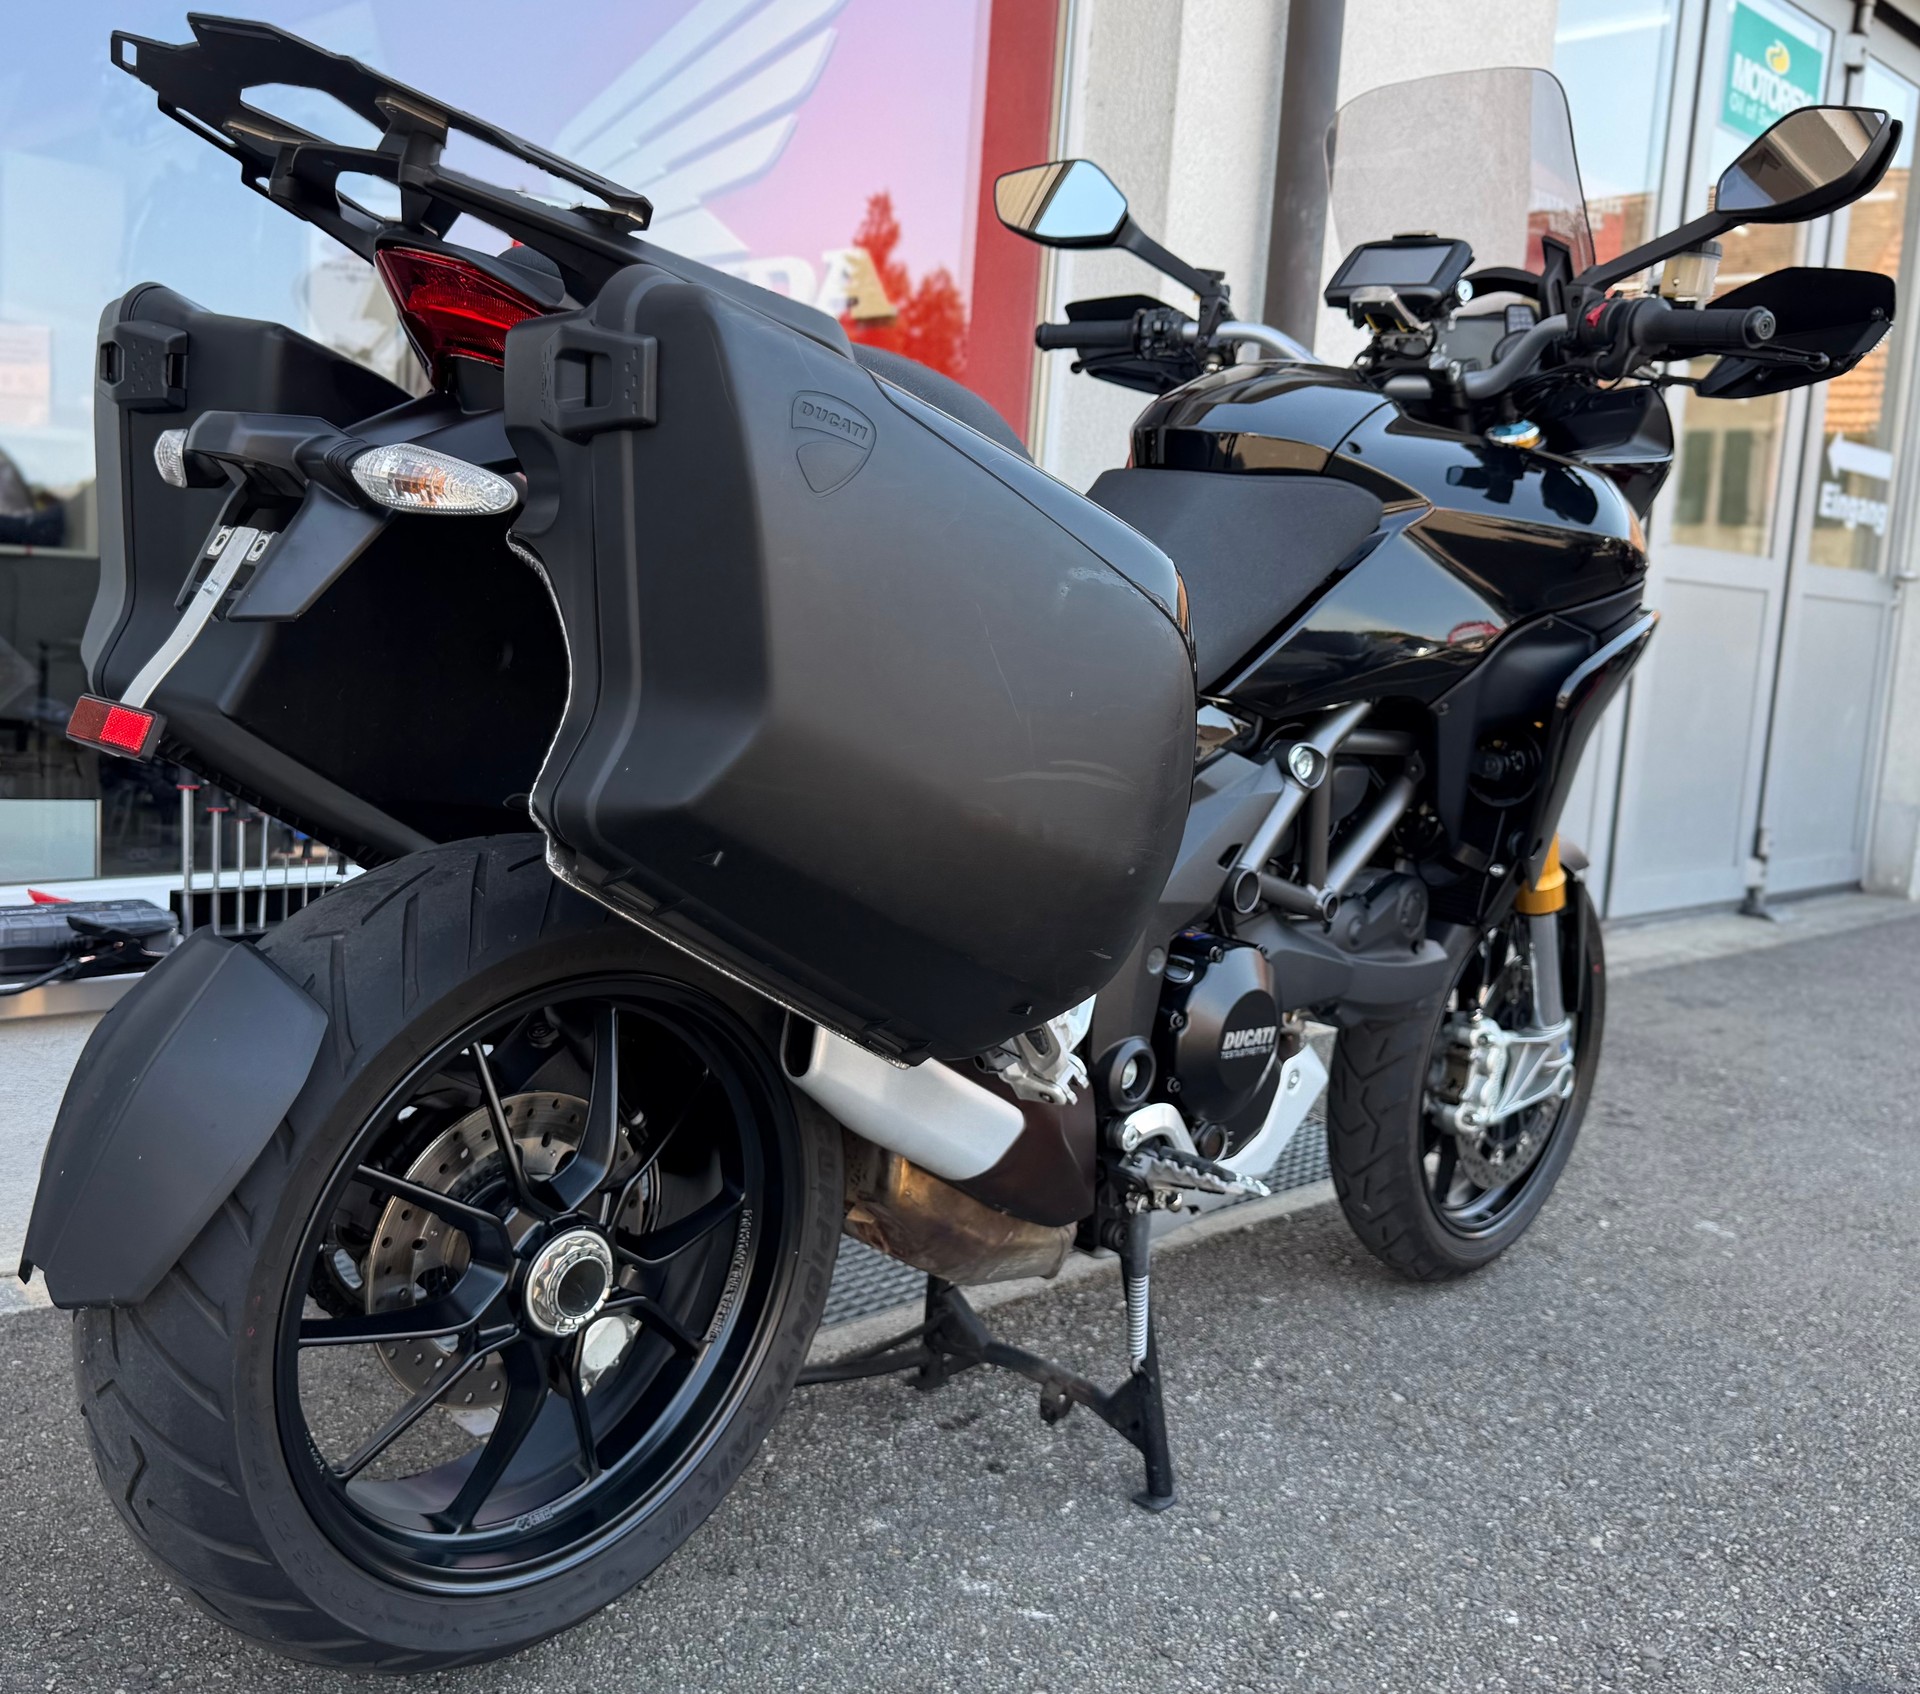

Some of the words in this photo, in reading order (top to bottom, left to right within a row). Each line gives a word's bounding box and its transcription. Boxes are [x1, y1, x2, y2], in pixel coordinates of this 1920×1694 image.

[802, 401, 868, 440] DUCATI
[1819, 481, 1888, 535] Eingang
[1222, 1025, 1276, 1050] DUCATI
